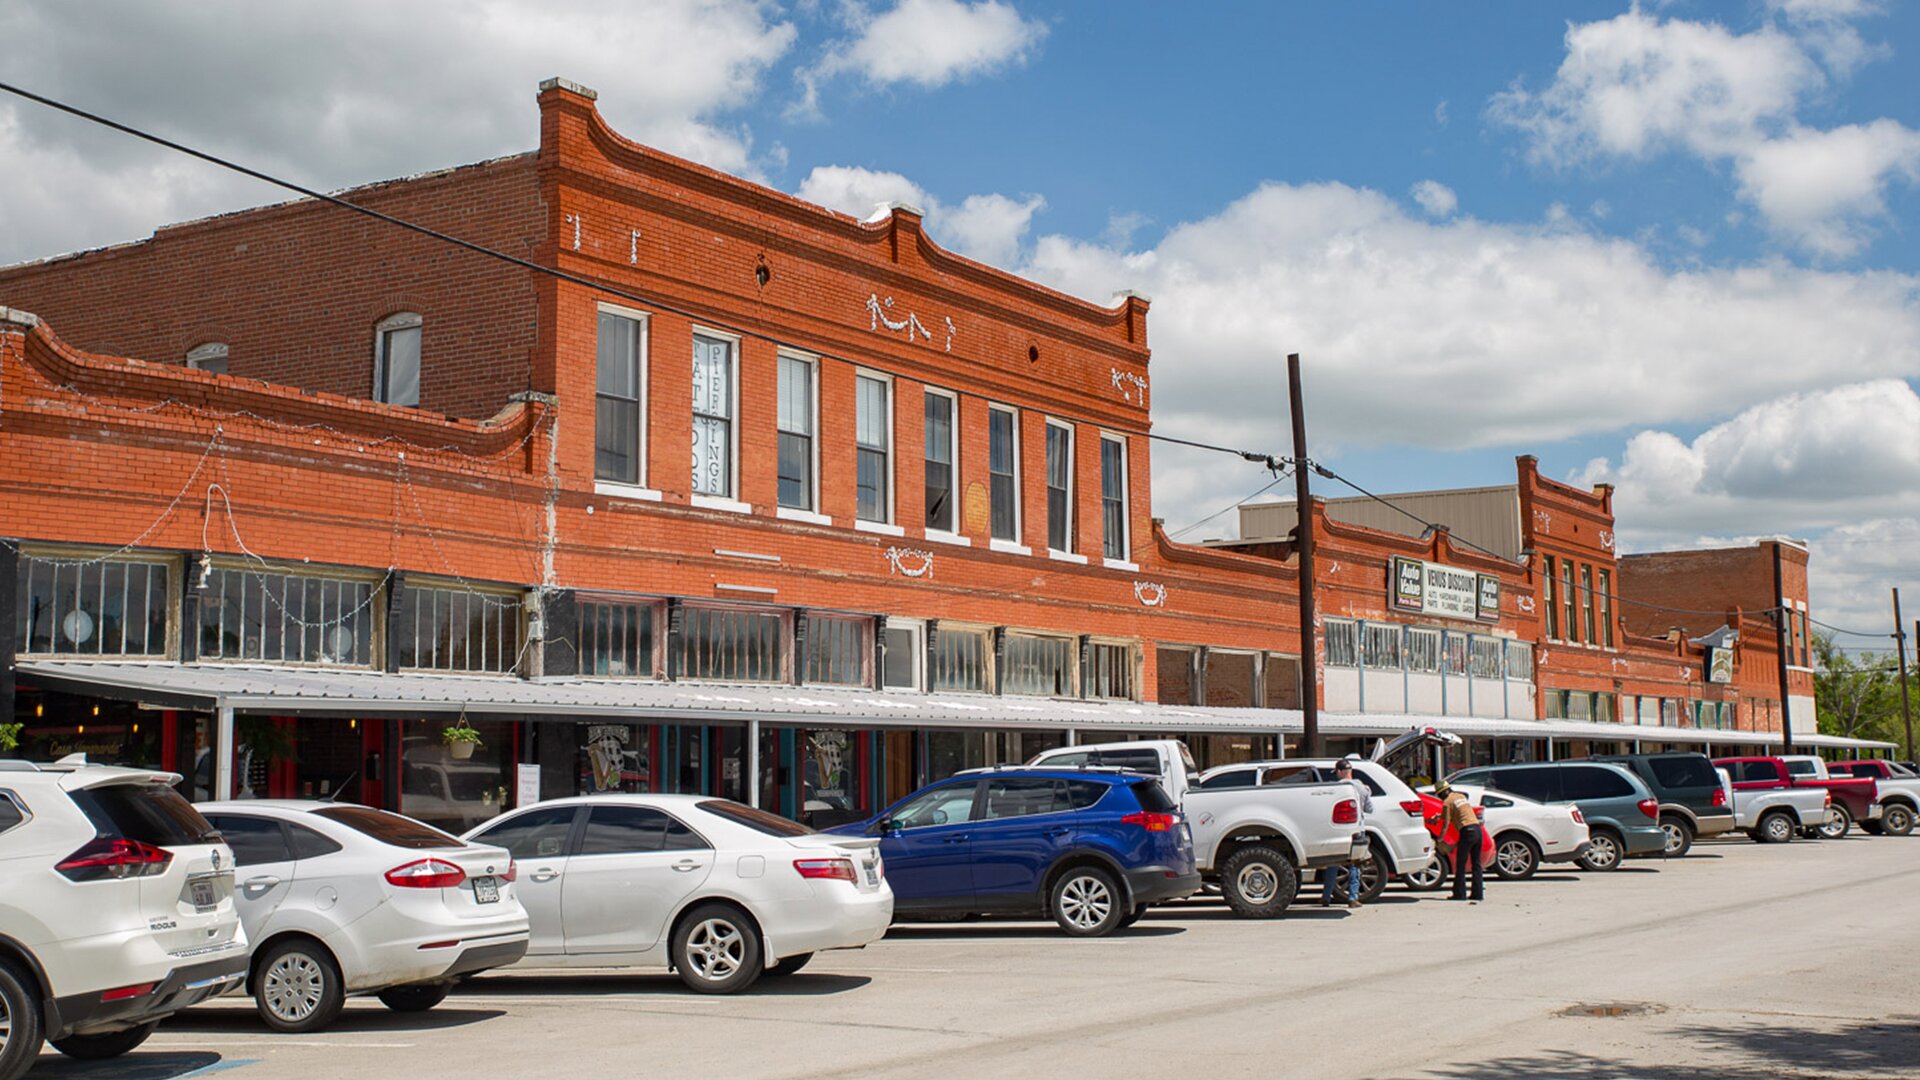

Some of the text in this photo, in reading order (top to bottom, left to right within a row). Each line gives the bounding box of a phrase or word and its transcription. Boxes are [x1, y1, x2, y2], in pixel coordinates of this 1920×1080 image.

[709, 346, 720, 493] PIERCINGS
[1401, 563, 1420, 581] Auto
[1427, 569, 1474, 592] VENUS DISCOUNT
[1400, 577, 1420, 597] Value
[1482, 579, 1497, 595] Auto
[1481, 592, 1498, 609] Value
